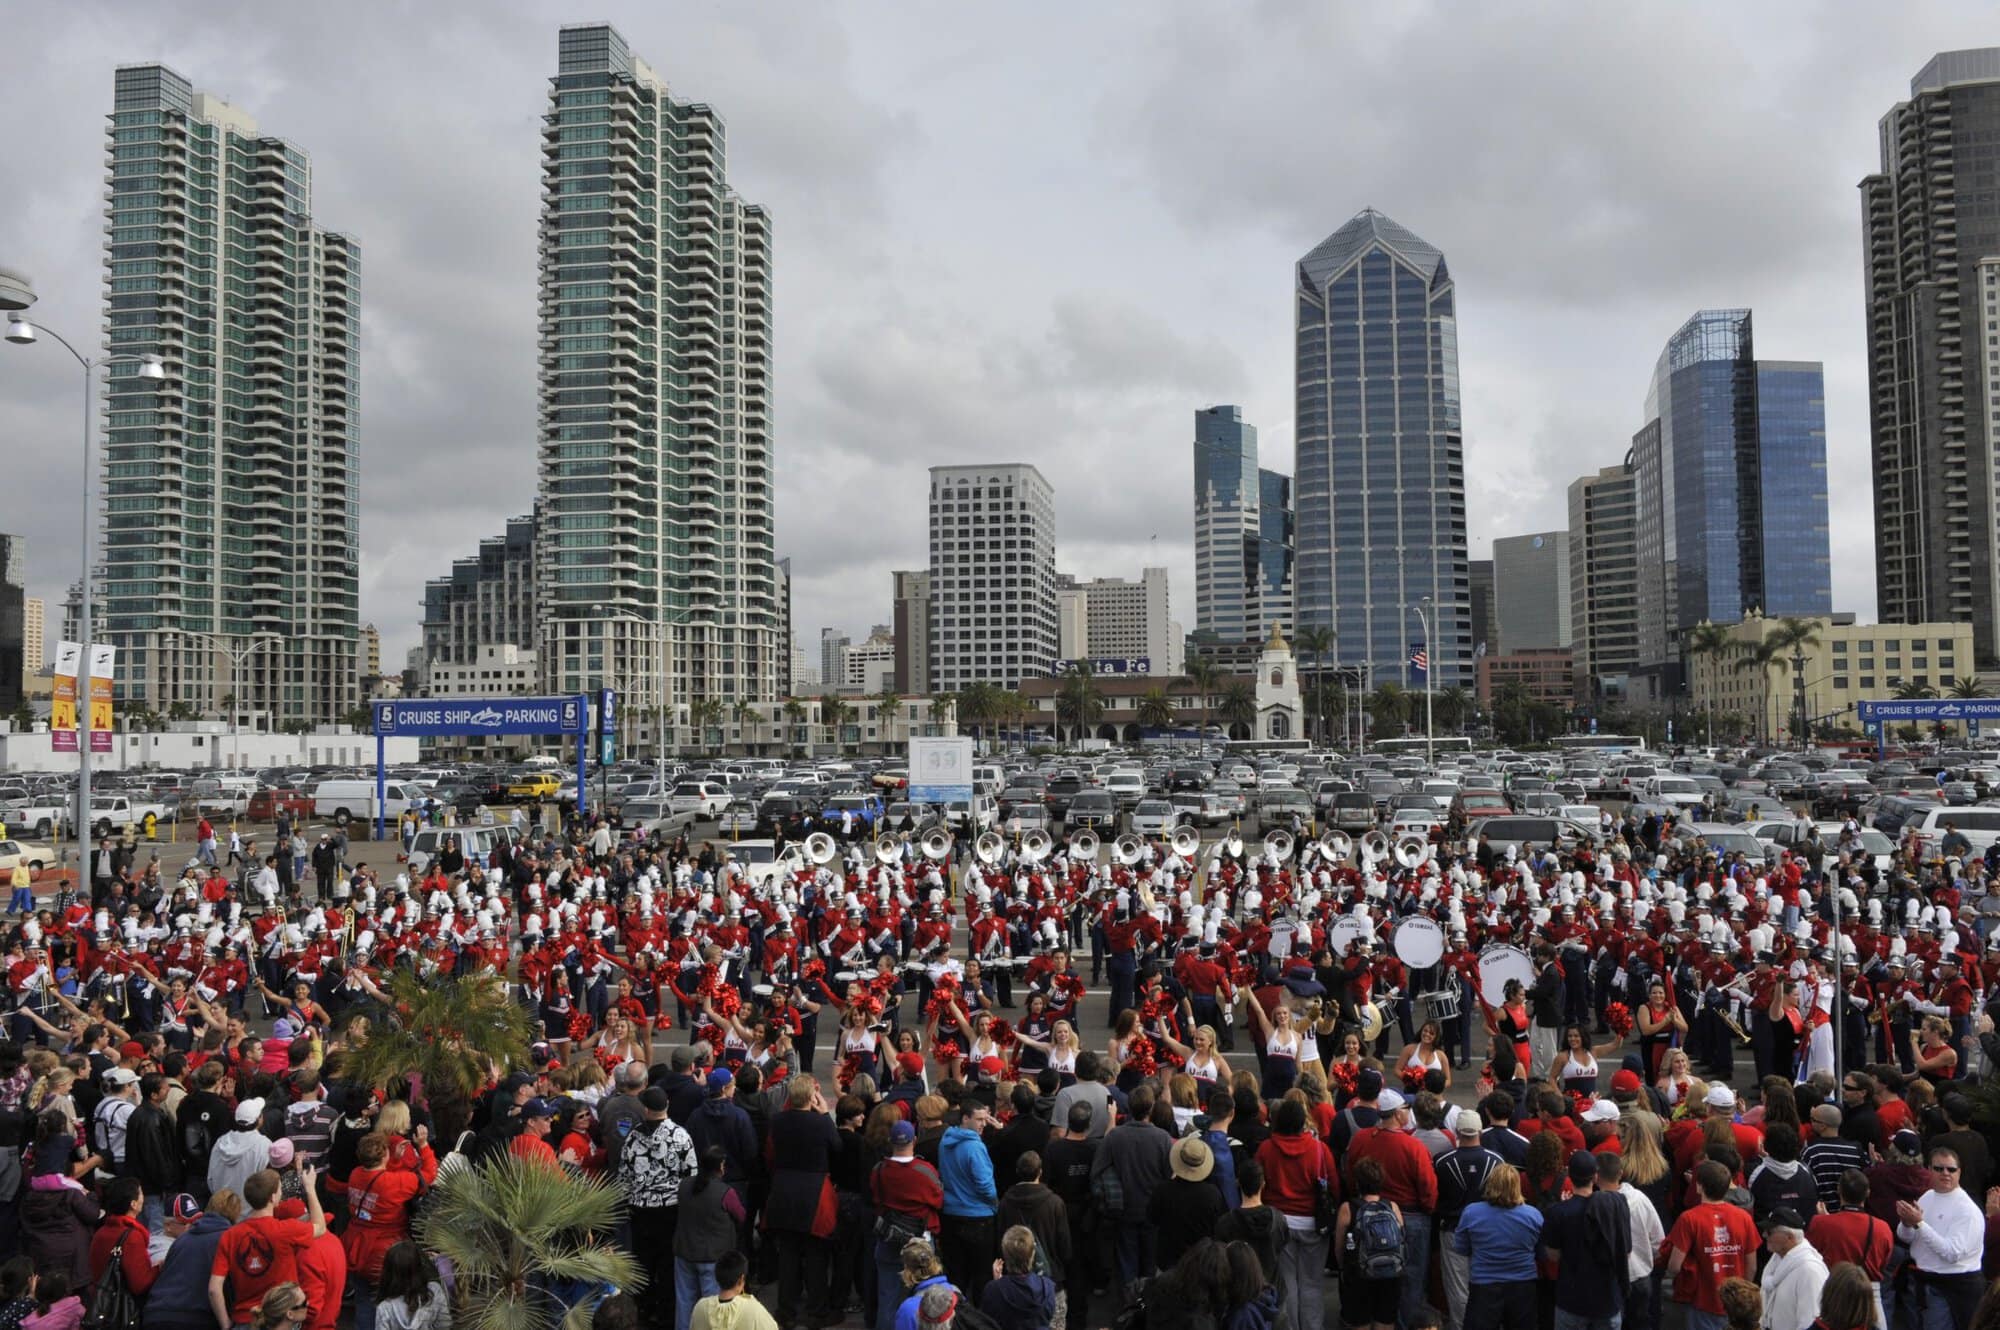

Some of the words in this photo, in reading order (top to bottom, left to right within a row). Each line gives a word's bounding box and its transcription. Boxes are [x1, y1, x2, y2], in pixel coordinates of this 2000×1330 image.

[1055, 659, 1114, 673] Sata
[1126, 659, 1147, 673] Fe
[565, 703, 575, 719] 5
[606, 691, 613, 719] 5
[1876, 706, 1913, 714] CRUISE
[1914, 705, 1937, 714] SHIP
[382, 706, 392, 721] 5
[399, 710, 441, 725] CRUISE
[444, 710, 471, 724] SHIP
[505, 708, 558, 724] PARKING
[1867, 724, 1877, 734] P
[604, 740, 612, 760] P
